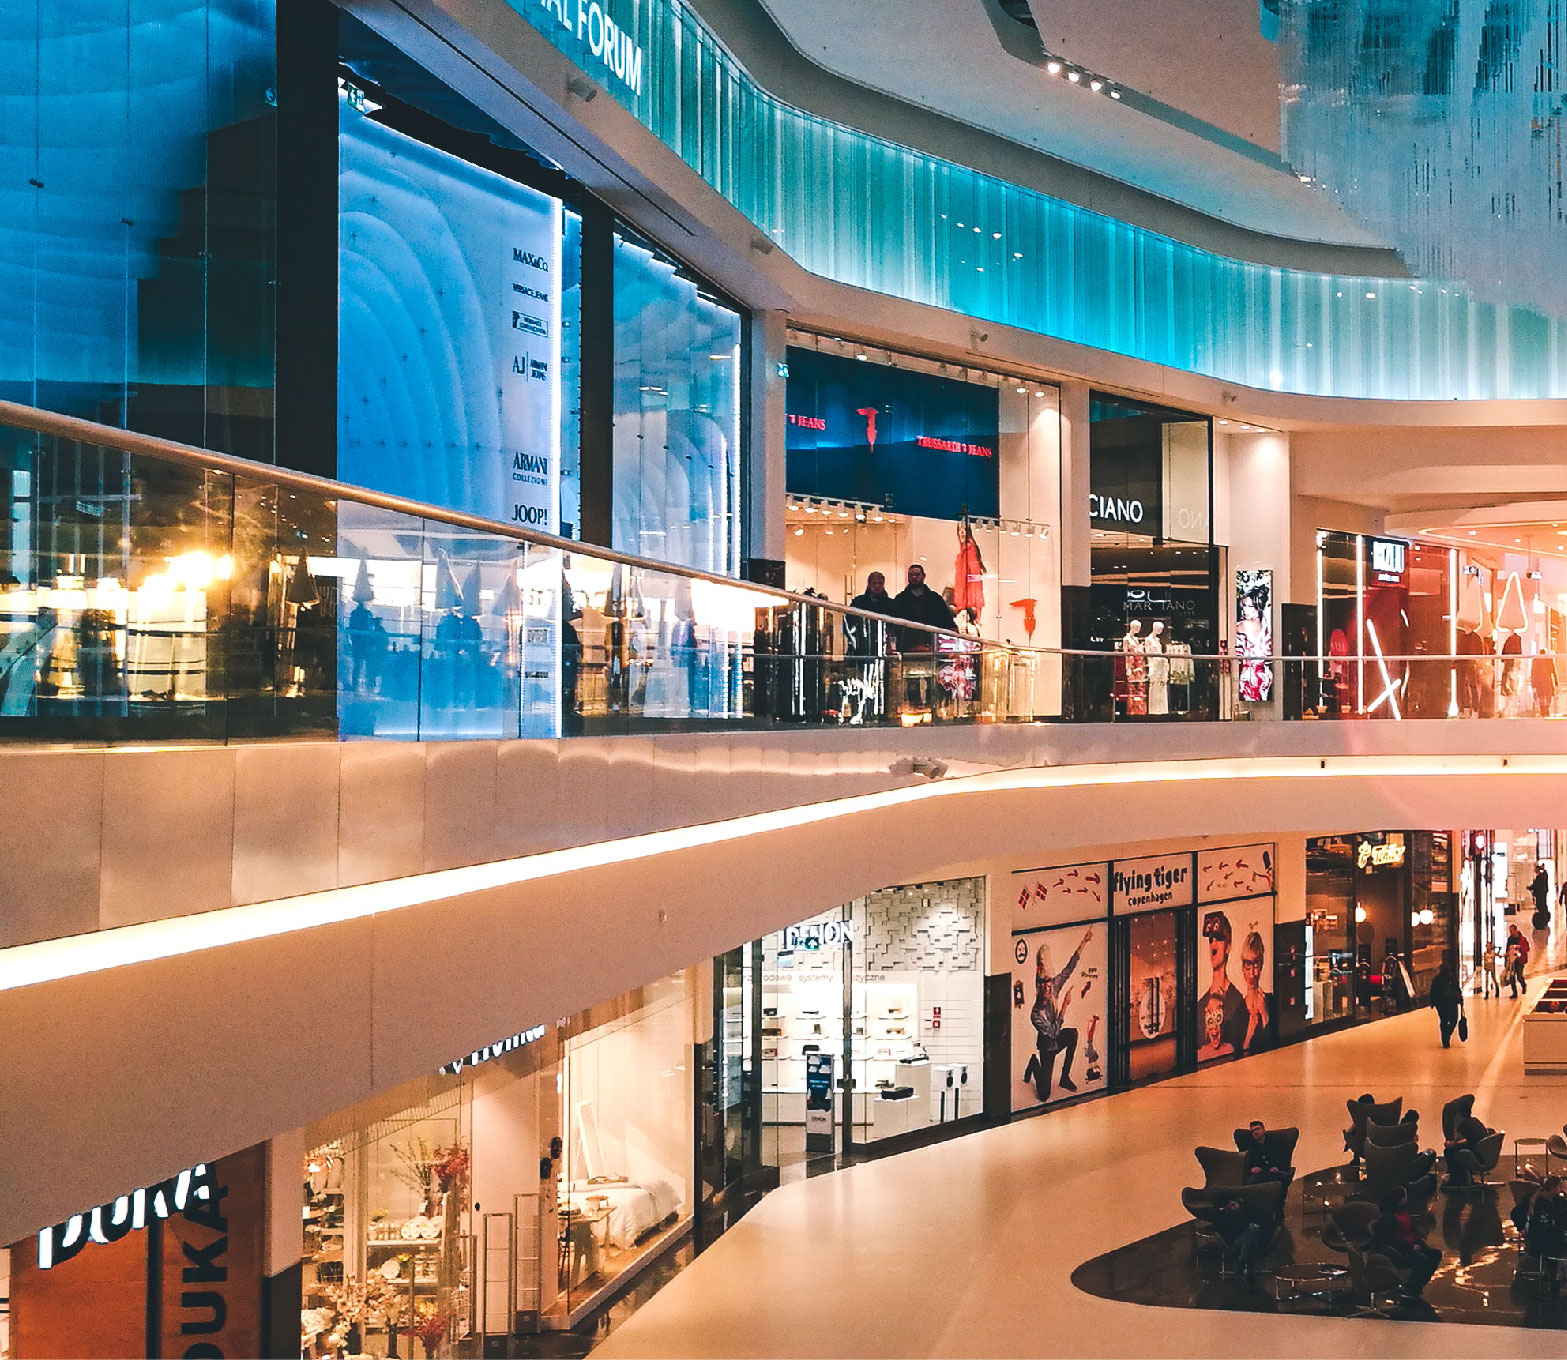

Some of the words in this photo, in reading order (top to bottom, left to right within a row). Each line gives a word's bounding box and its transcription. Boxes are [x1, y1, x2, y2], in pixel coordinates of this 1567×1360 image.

[577, 0, 641, 95] FORUM
[967, 443, 992, 457] JEANS
[513, 452, 548, 475] ARMANI
[512, 504, 548, 526] JOOP!
[1123, 600, 1196, 611] MARIANO
[1113, 869, 1152, 896] flying
[1154, 865, 1188, 889] tiger
[1128, 891, 1174, 907] copenhagen
